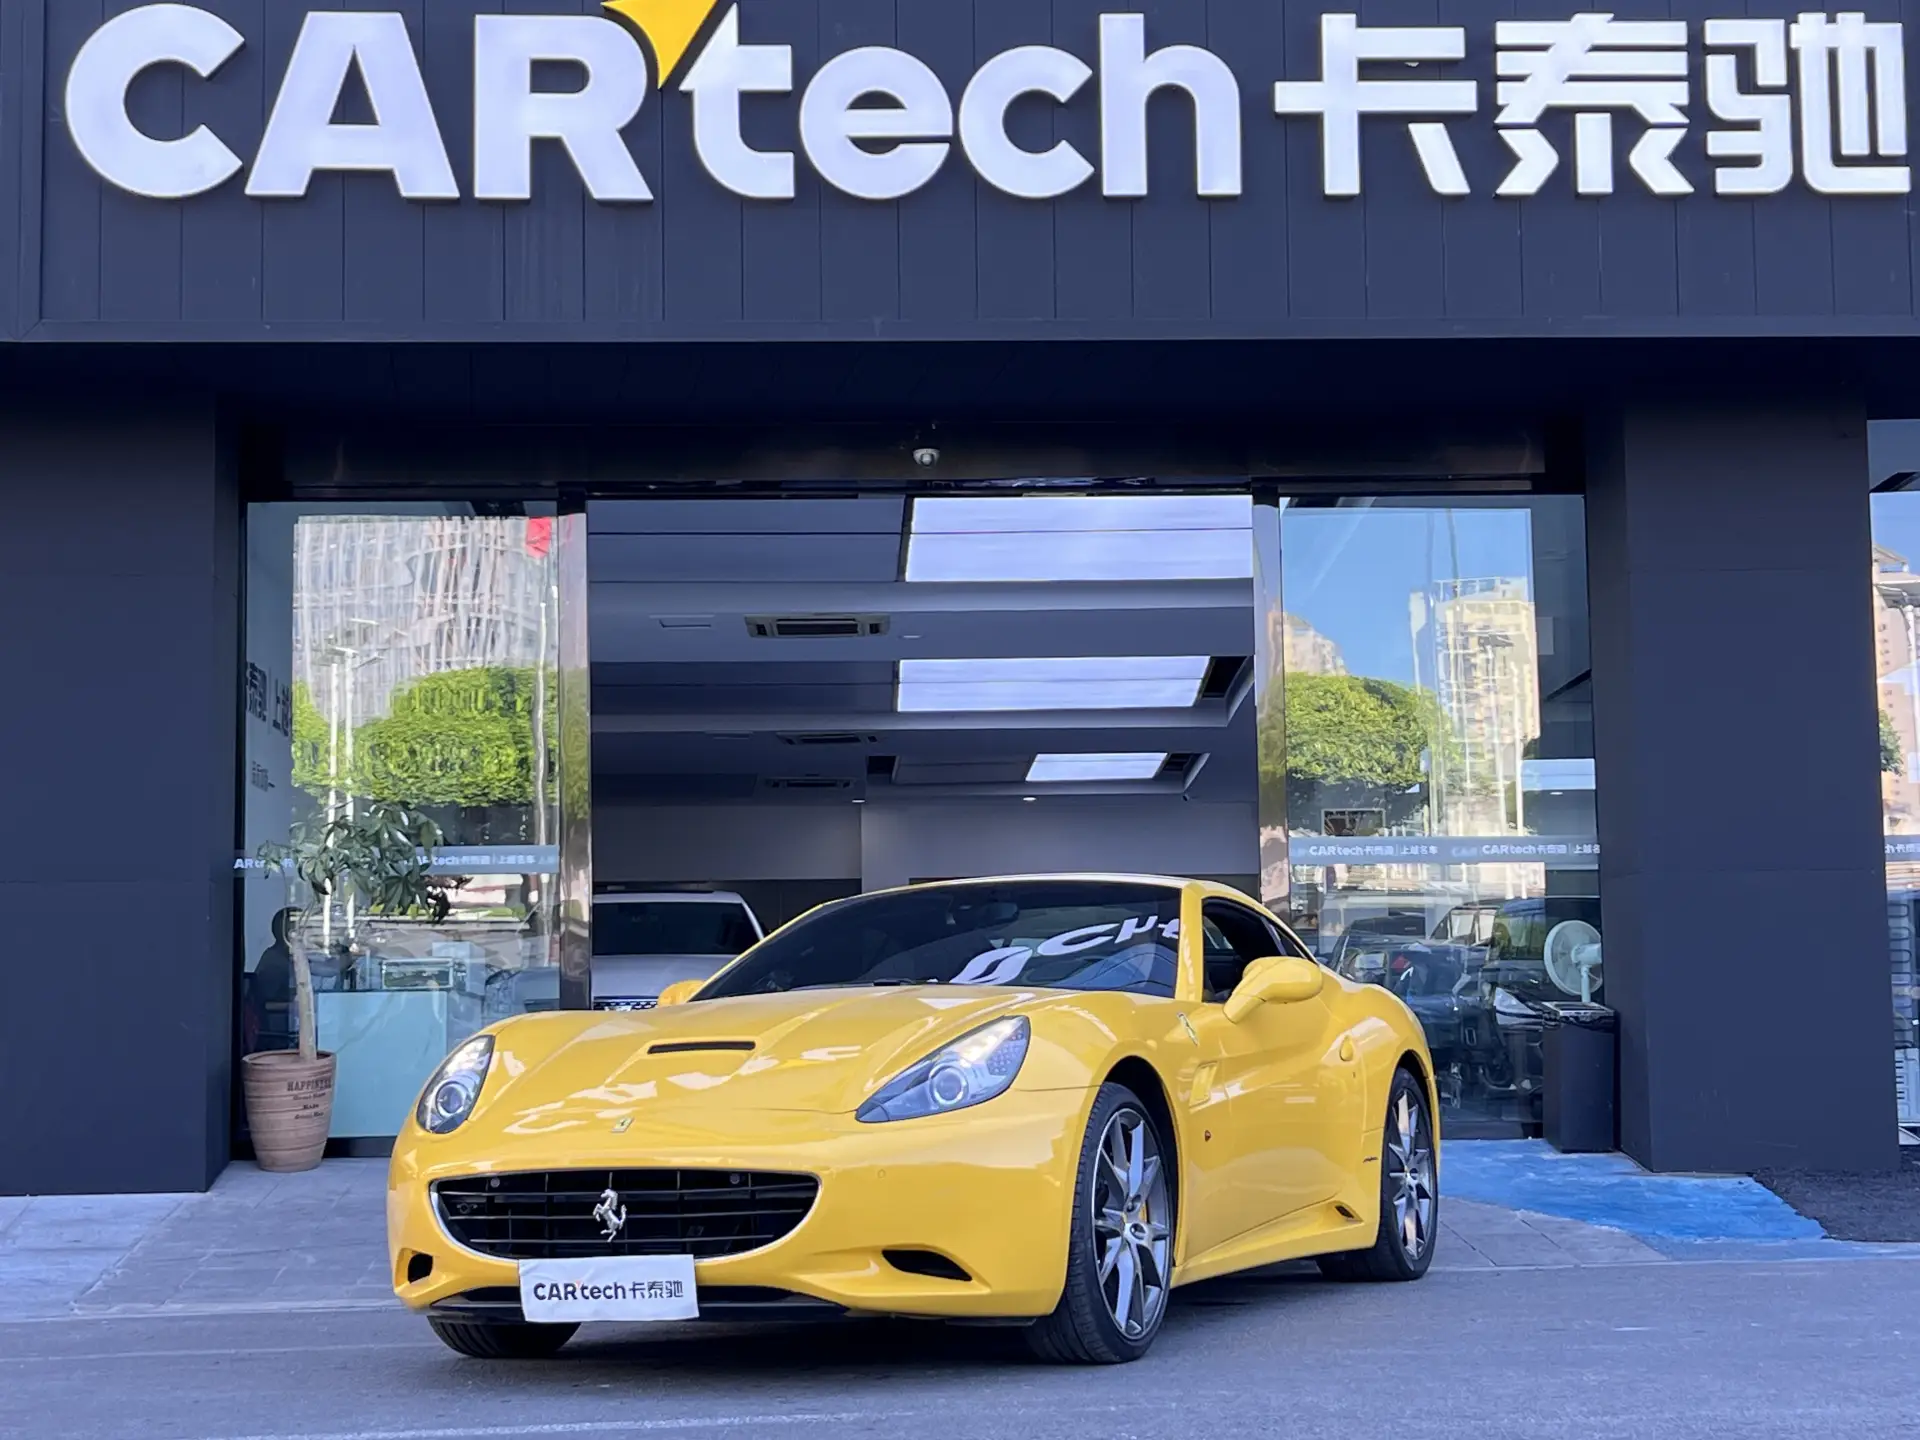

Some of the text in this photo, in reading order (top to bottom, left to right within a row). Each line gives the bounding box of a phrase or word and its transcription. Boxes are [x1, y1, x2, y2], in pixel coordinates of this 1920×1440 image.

[66, 3, 1912, 200] CARtech 卡泰驰
[1309, 844, 1364, 856] CARtech
[1482, 843, 1536, 855] CARtech
[533, 1280, 684, 1301] CARtech 卡泰驰
